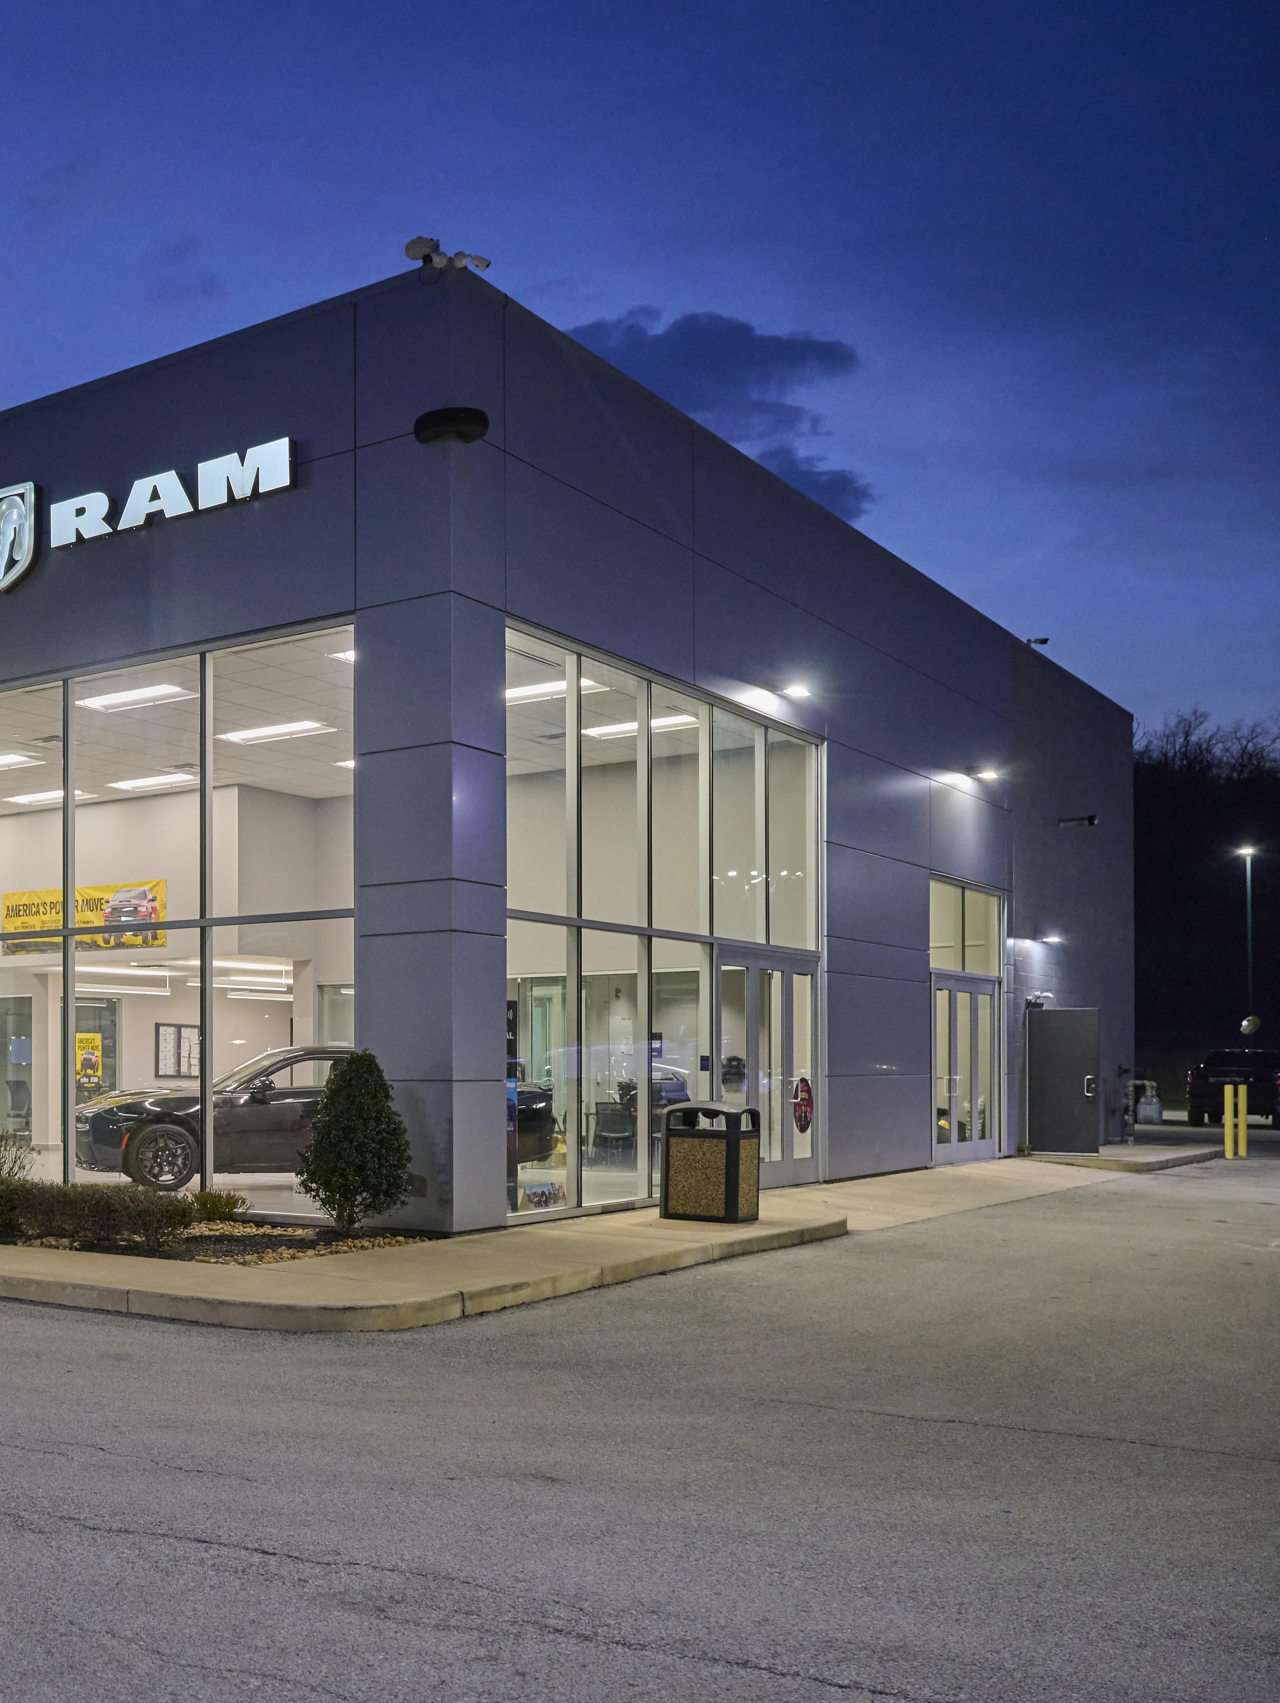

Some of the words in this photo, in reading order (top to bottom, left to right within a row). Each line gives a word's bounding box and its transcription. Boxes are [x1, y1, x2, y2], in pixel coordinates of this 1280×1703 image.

[50, 437, 291, 548] RAM
[6, 902, 48, 918] AMERICA'S
[81, 897, 105, 912] MOVE
